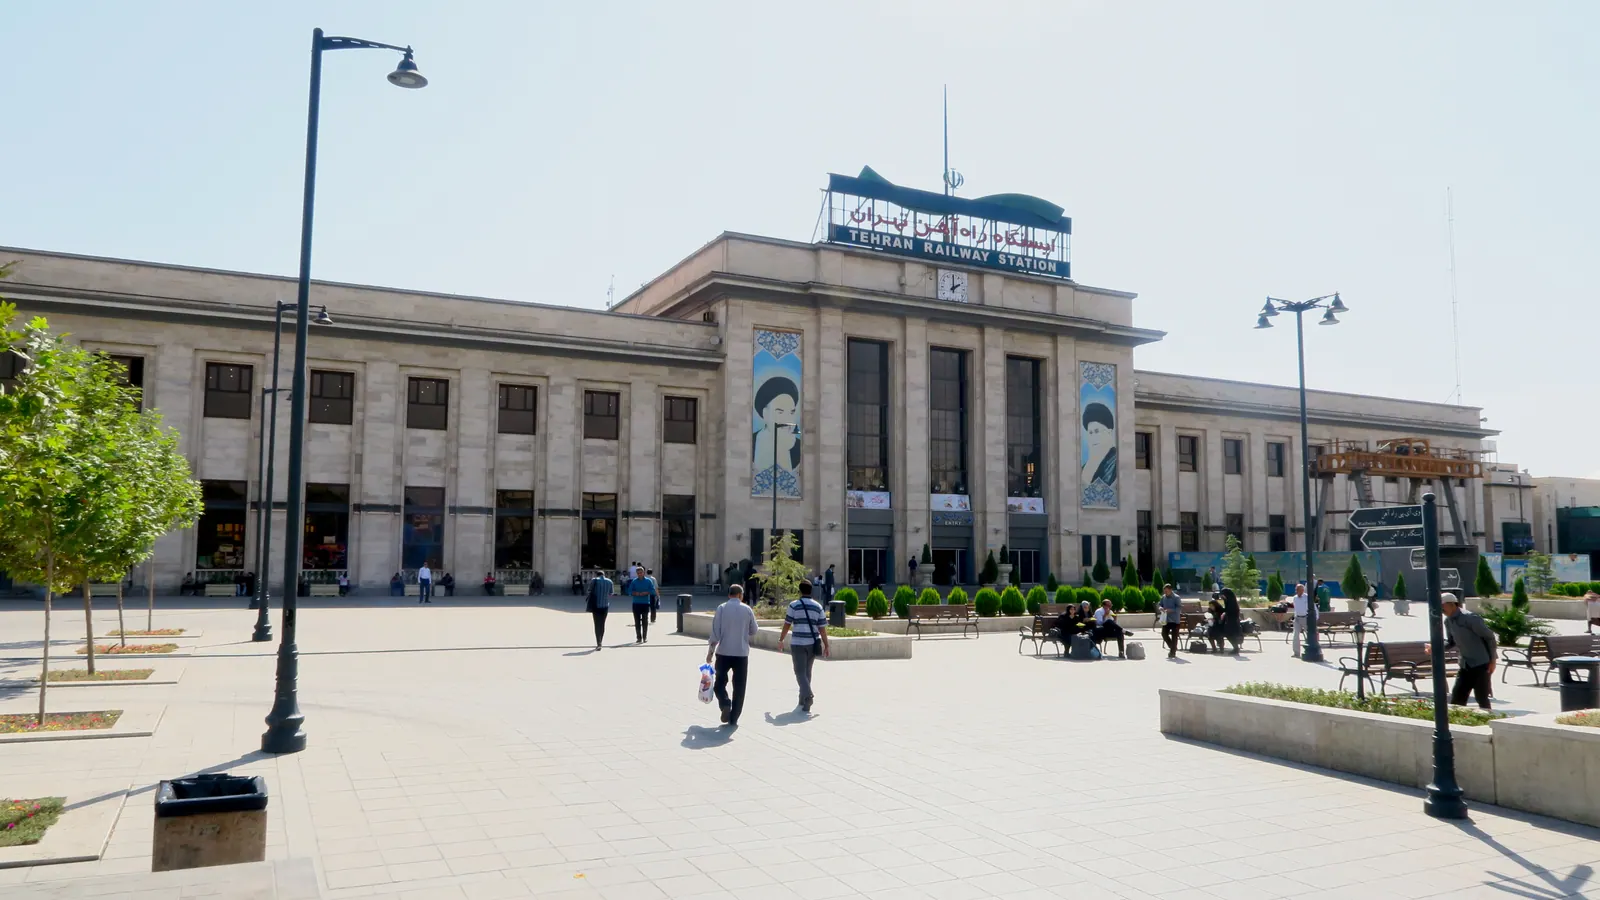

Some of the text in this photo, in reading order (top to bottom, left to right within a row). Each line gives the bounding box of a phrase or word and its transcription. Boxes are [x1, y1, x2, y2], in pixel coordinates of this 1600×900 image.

[849, 229, 1057, 273] TEHRAN RAILWAY STATION
[850, 207, 1056, 256] ایستگاه راه آهن تهران
